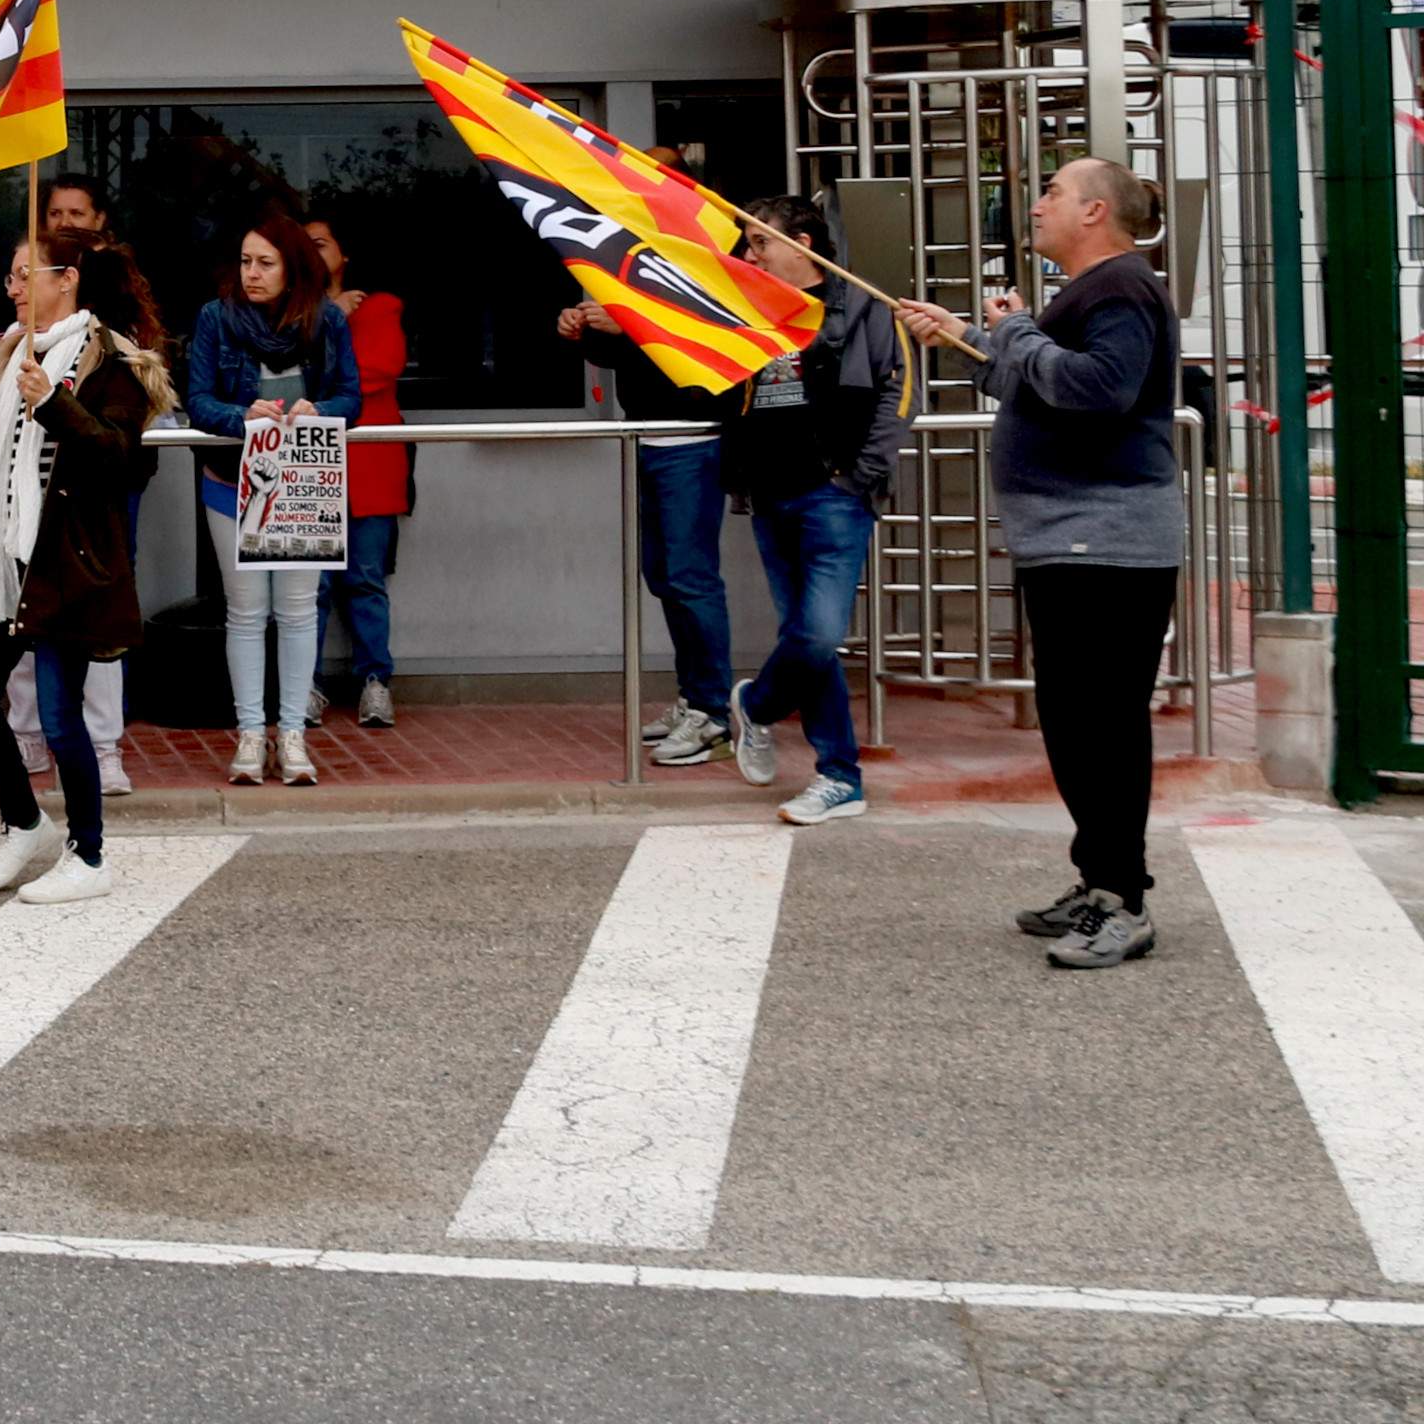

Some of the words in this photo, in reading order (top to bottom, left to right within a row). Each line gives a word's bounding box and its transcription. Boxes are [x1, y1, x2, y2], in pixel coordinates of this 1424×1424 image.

[248, 427, 281, 457] NO
[283, 433, 294, 445] AL
[296, 426, 339, 448] ERE
[278, 451, 289, 461] DE
[281, 470, 298, 484] NO
[318, 470, 343, 485] 301
[287, 485, 343, 498] DESPIDOS
[274, 502, 287, 512] NO
[288, 502, 318, 512] SOMOS
[265, 524, 295, 534] SOMOS
[297, 524, 342, 535] PERSONAS
